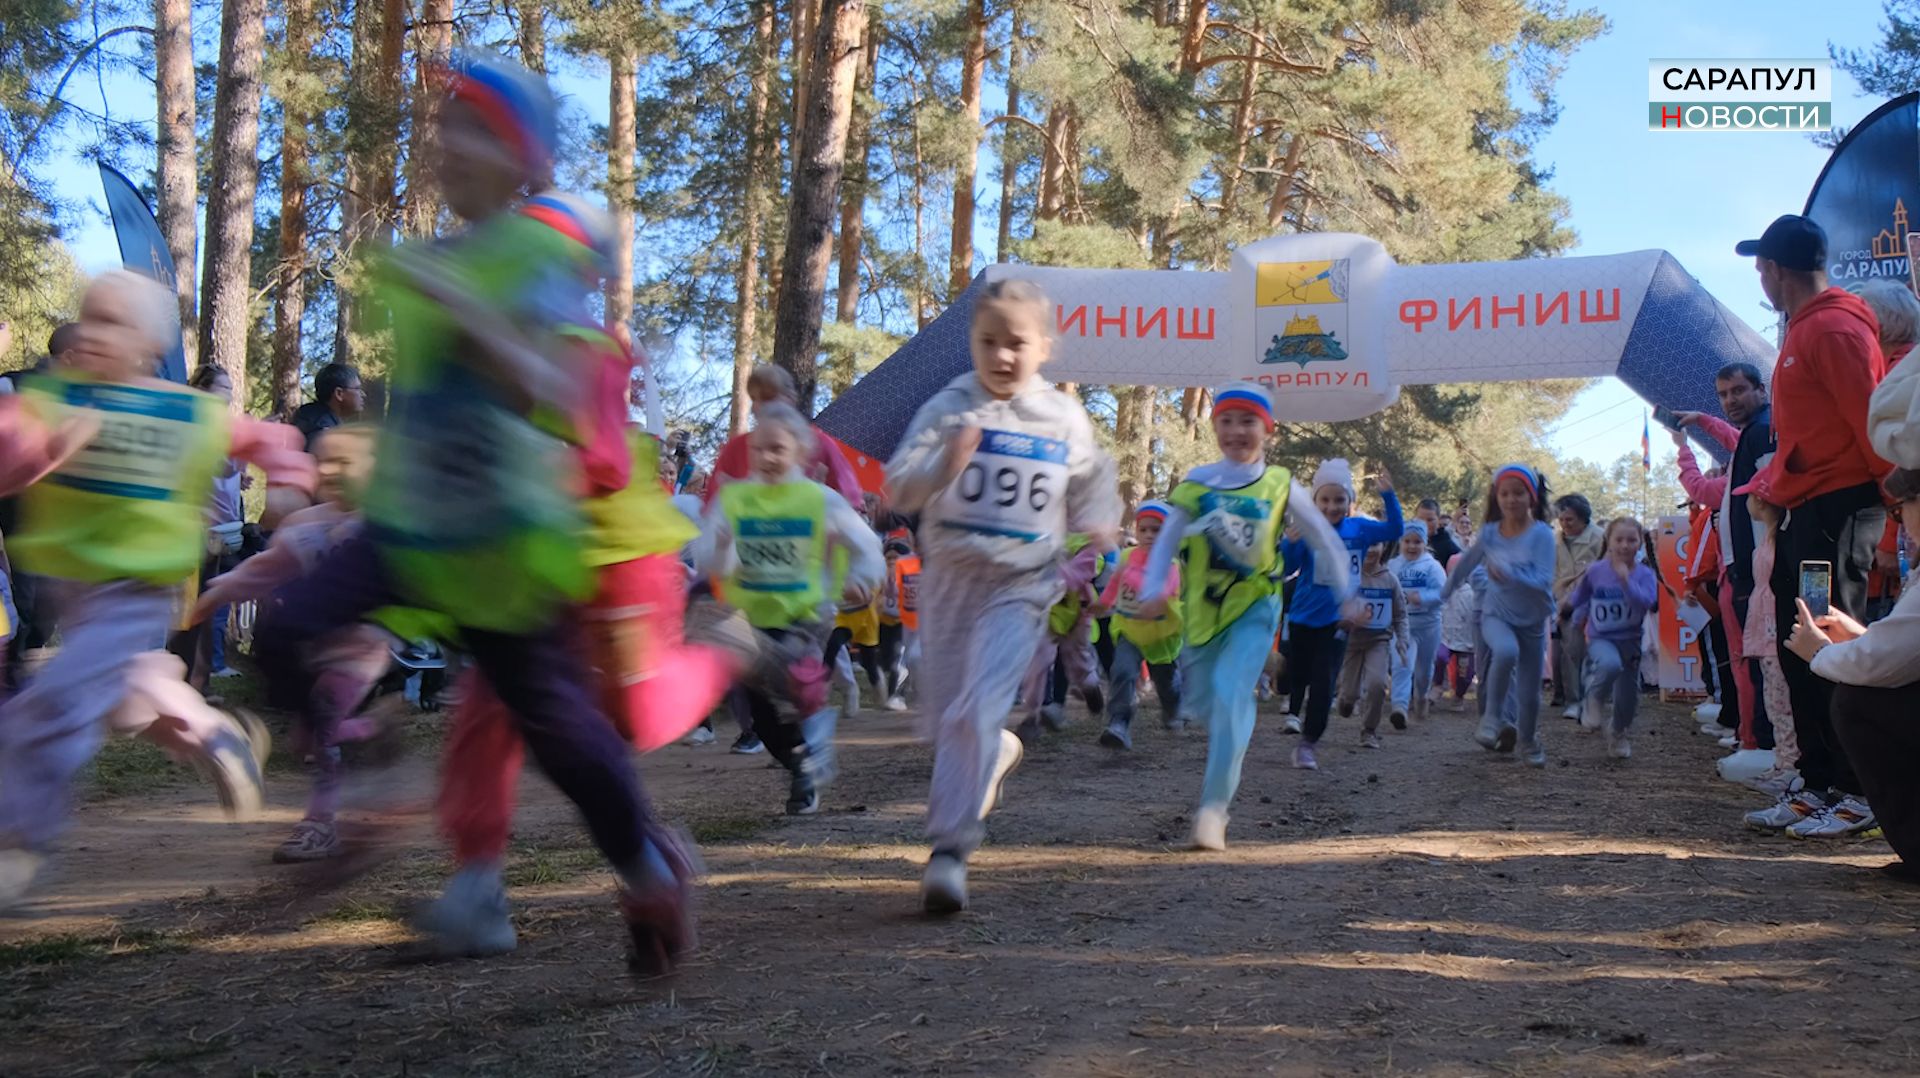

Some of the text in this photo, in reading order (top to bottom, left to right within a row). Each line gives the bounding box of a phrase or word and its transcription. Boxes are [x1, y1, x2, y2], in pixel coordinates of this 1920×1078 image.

[1840, 250, 1872, 261] ГОРОД
[1056, 305, 1215, 340] ИНИШ
[1399, 288, 1620, 332] ФИНИШ
[960, 461, 1050, 511] 096
